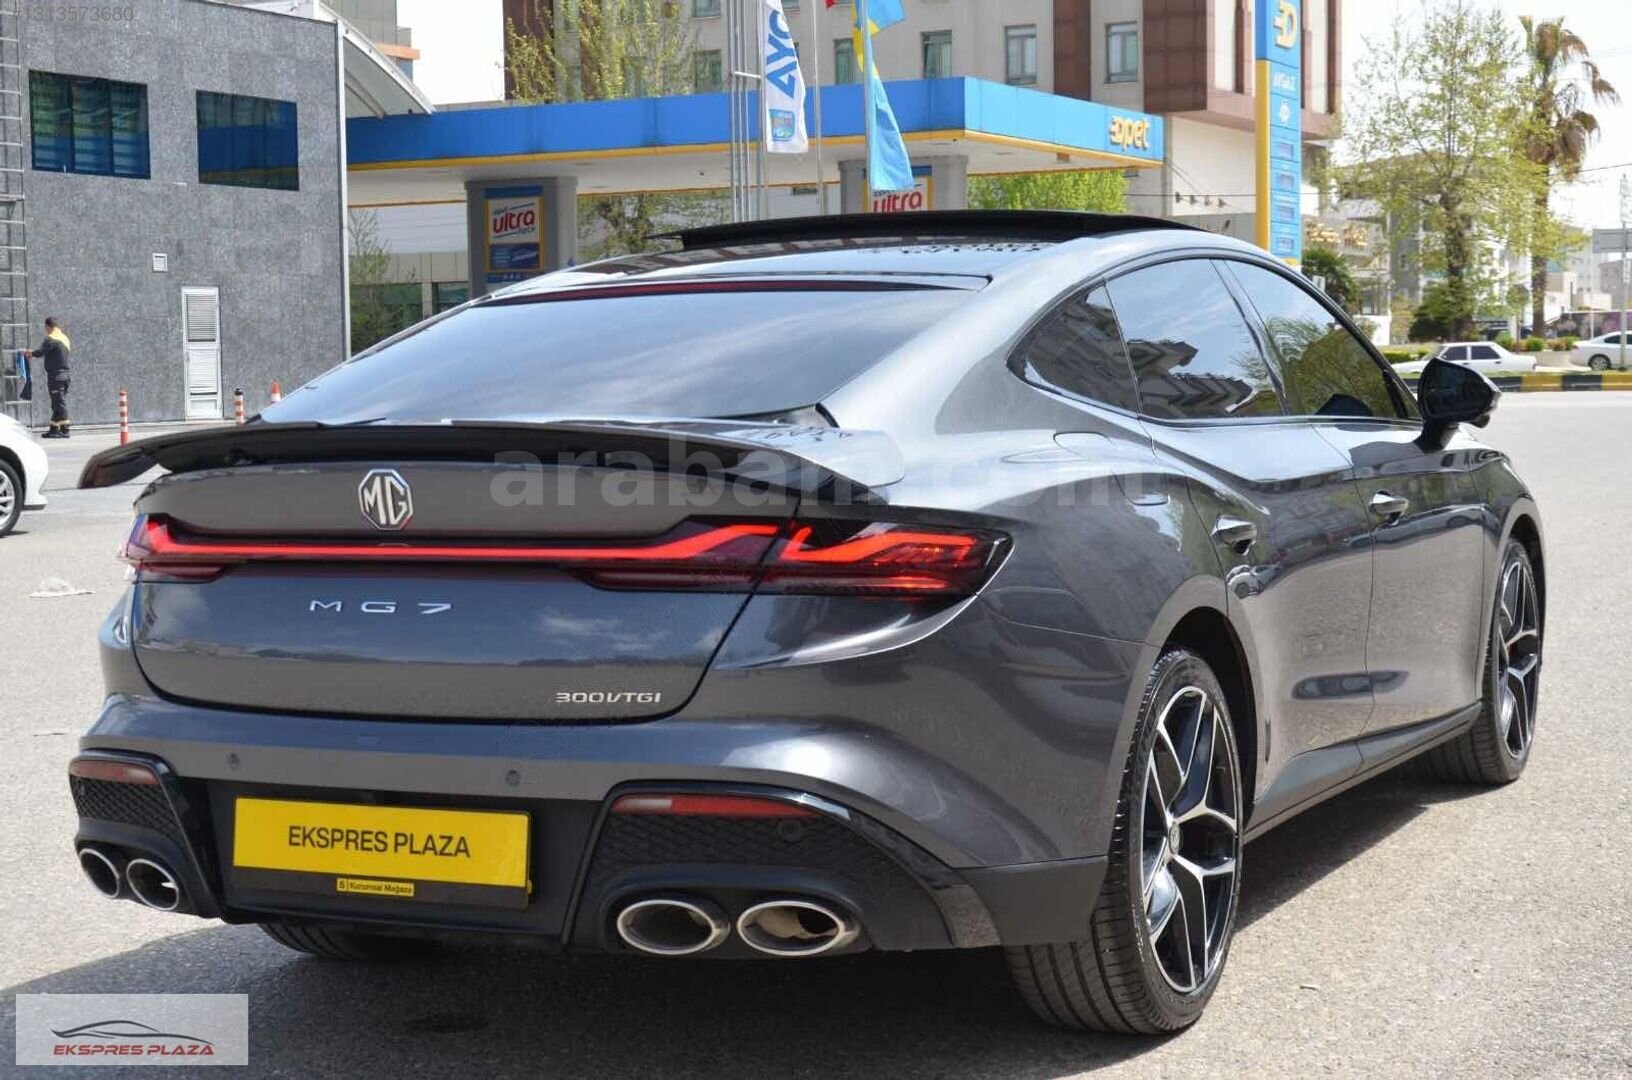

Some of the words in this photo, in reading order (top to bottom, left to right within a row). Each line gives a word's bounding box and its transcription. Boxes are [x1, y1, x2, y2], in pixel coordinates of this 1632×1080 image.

[492, 209, 536, 234] ultra
[362, 475, 409, 526] MG
[288, 825, 389, 853] EKSPRES
[393, 831, 471, 859] PLAZA
